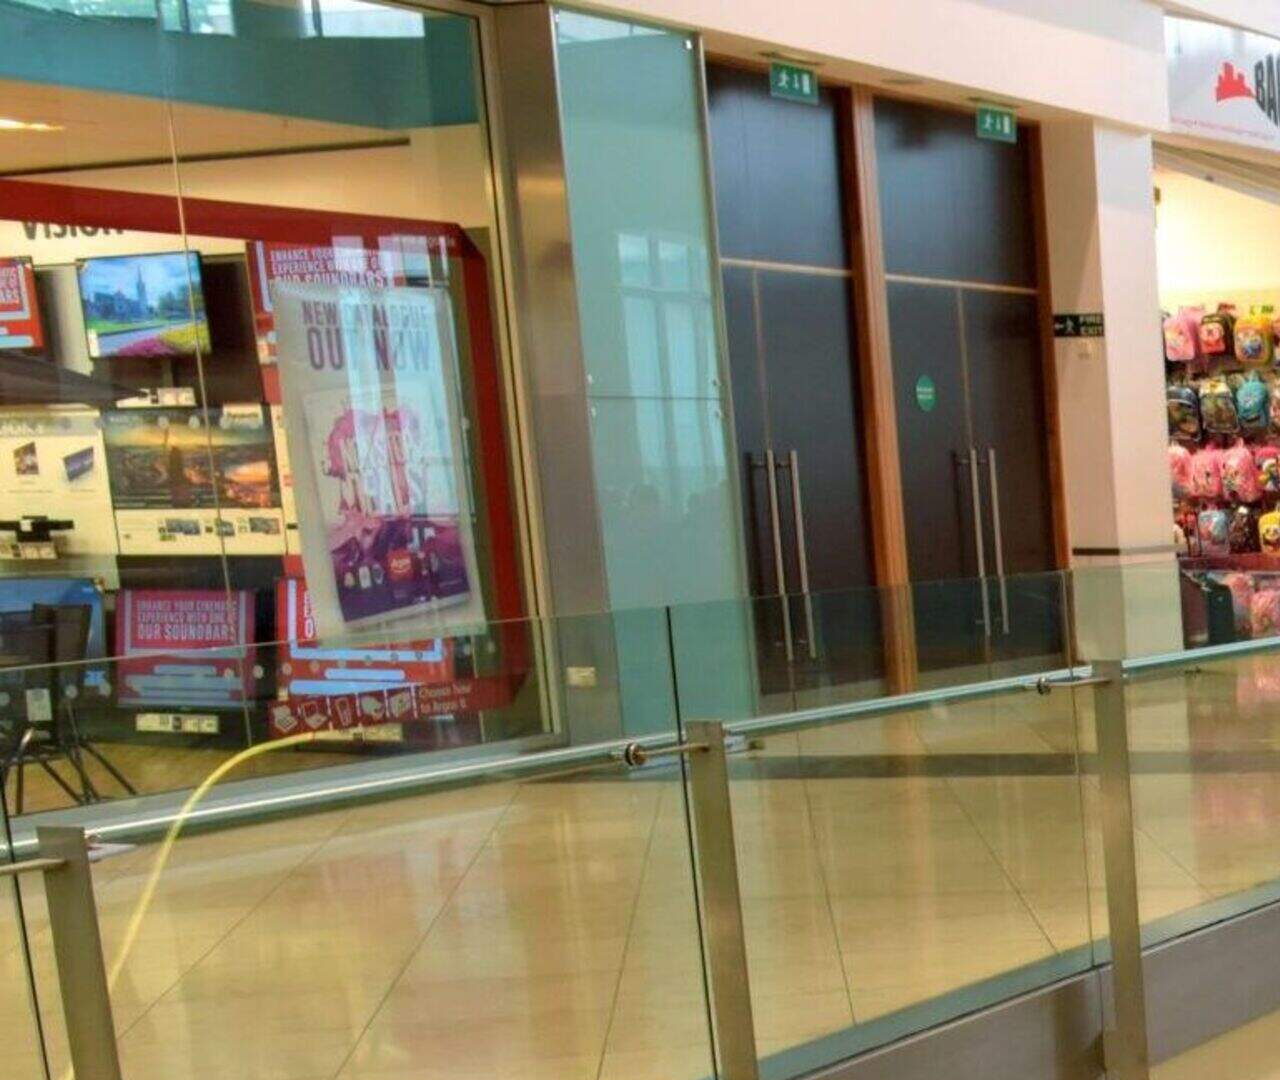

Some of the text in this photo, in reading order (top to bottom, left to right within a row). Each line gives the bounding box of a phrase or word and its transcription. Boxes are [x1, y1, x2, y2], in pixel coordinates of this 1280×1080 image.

[21, 221, 124, 241] VISIO
[302, 301, 338, 325] NEW
[307, 327, 431, 372] OUT NOW
